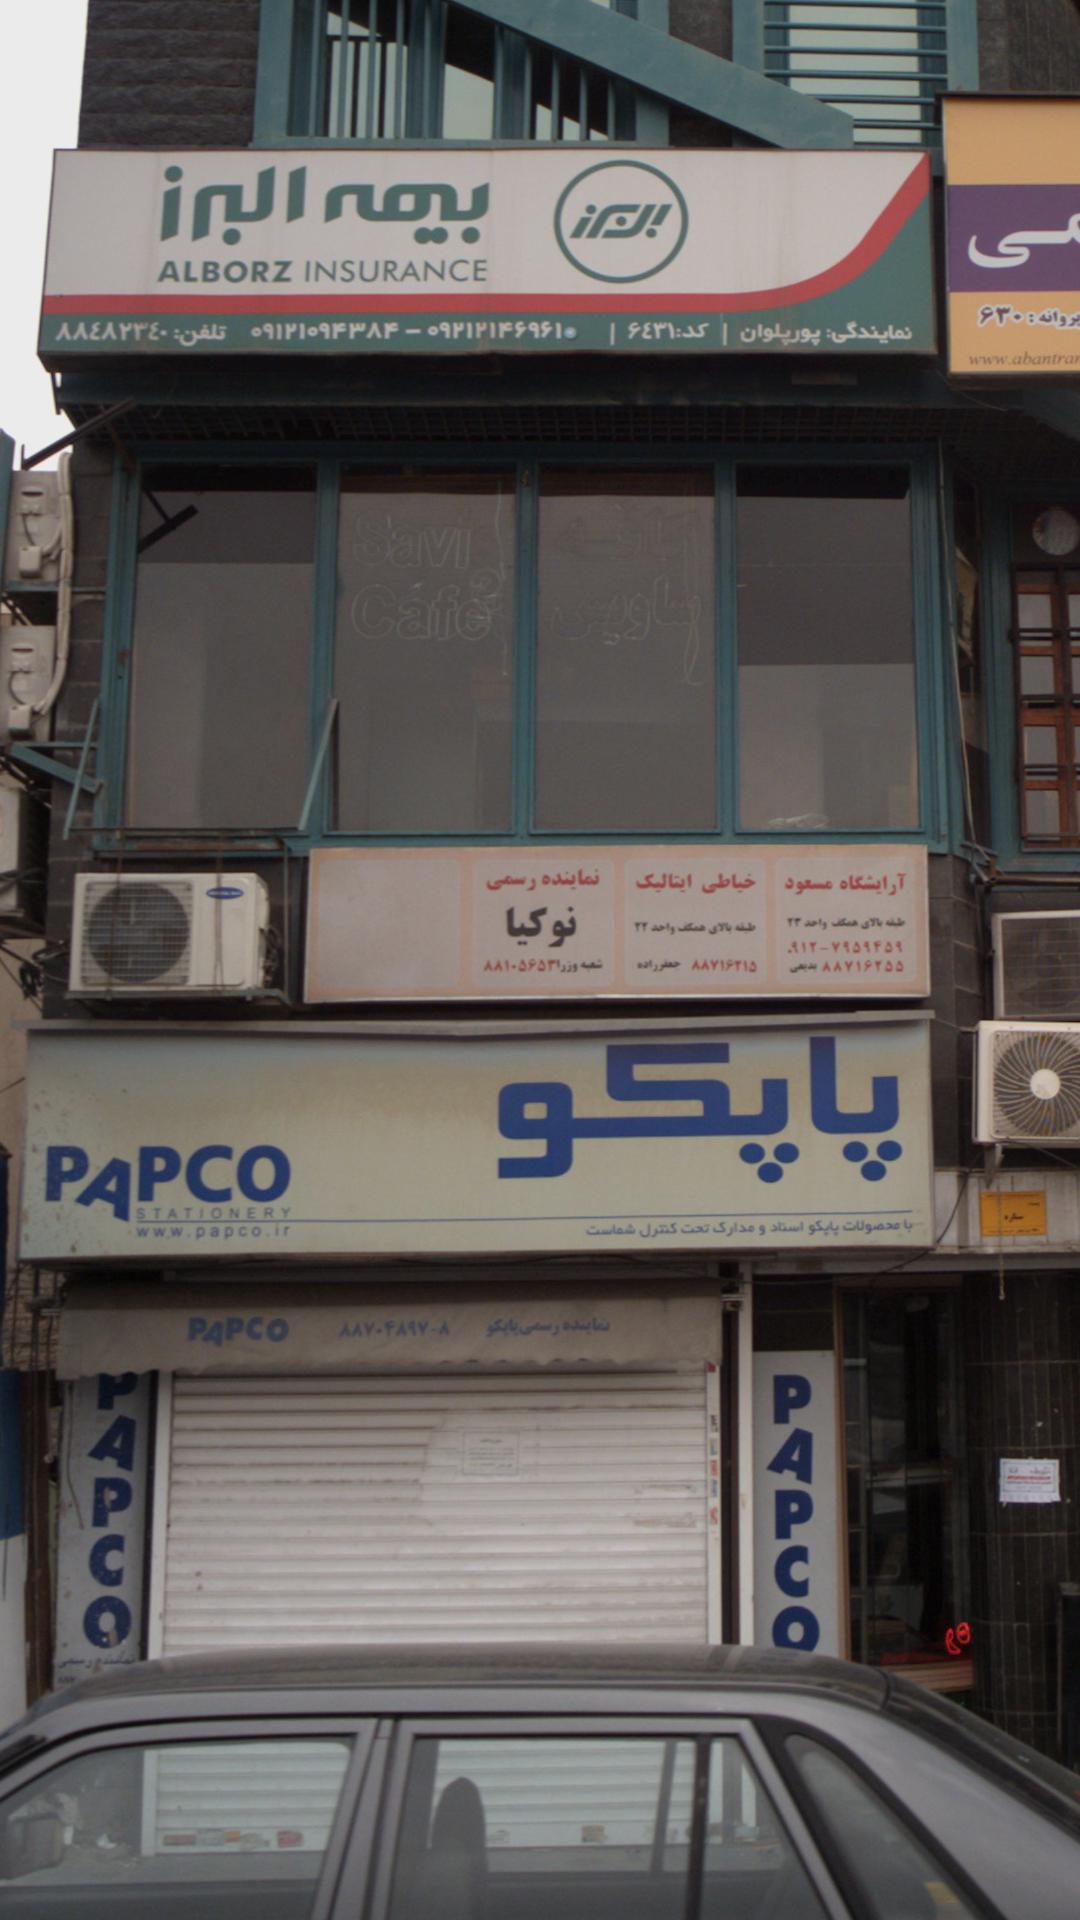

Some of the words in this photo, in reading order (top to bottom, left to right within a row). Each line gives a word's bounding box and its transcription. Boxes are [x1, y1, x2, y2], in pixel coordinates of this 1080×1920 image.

[160, 165, 307, 246] البرز
[324, 183, 490, 245] بیمه
[157, 260, 293, 283] ALBORZ
[304, 259, 488, 283] INSURANCE
[486, 874, 537, 891] رسمی
[542, 868, 600, 889] نماینده
[635, 872, 693, 893] ایتالیک
[701, 872, 757, 894] خیاطی
[784, 877, 833, 895] مسعود
[839, 873, 906, 896] آرایشگاه
[506, 906, 577, 947] نوکیا
[497, 1036, 903, 1184] پاپکو
[44, 1144, 291, 1222] PAPCO
[135, 1207, 291, 1219] STATIONERY
[135, 1222, 291, 1240] www.papco.ir
[842, 1220, 900, 1235] محصولات
[186, 1315, 290, 1347] PAPCO
[766, 1373, 821, 1653] PAPCO
